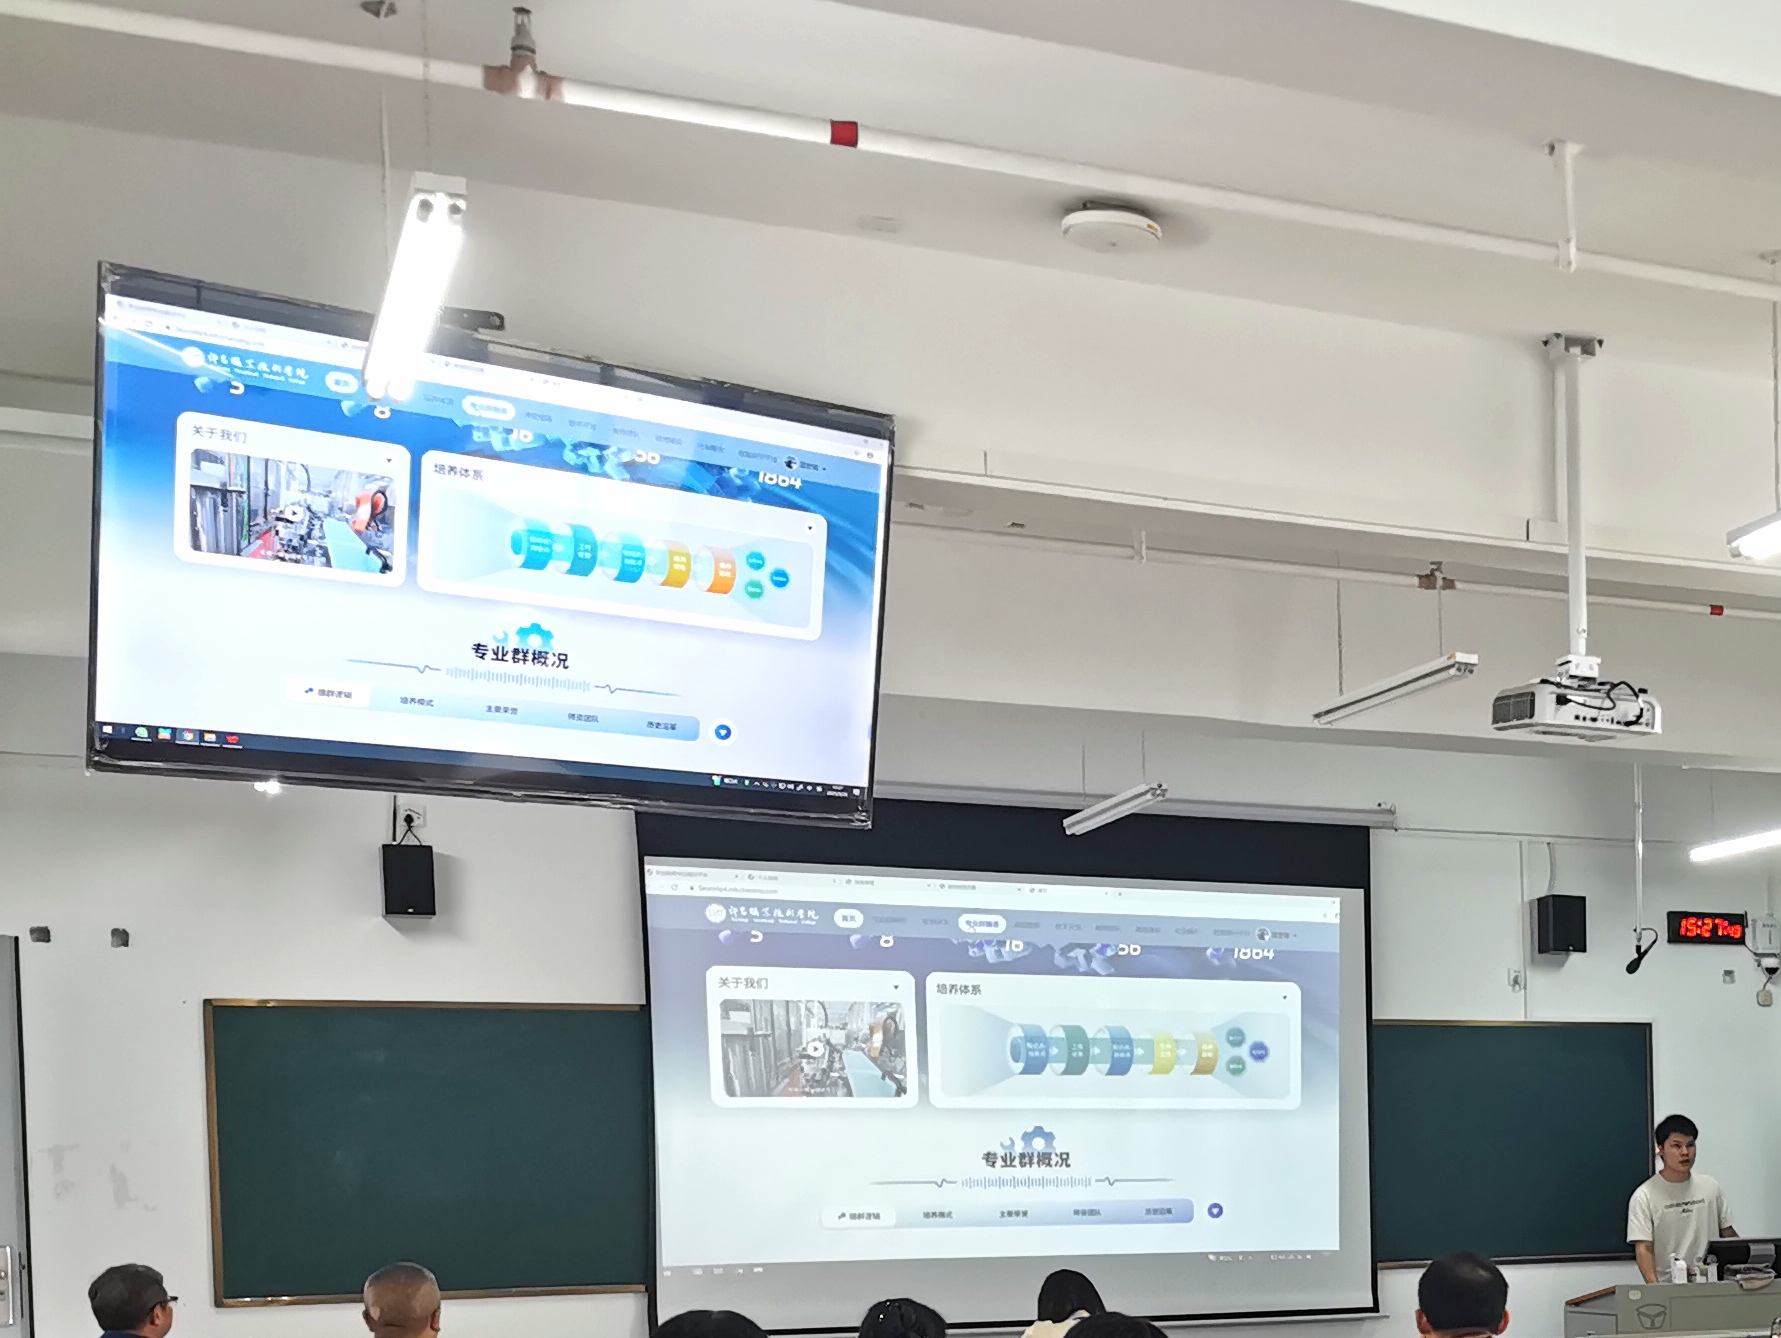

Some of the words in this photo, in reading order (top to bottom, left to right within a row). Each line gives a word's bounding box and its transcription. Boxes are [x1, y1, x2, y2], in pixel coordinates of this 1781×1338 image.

[190, 423, 248, 445] 关于我们
[433, 462, 484, 481] 培养体系
[470, 642, 570, 670] 专业群概况
[717, 976, 769, 990] 关于我们
[936, 982, 982, 996] 培养体系
[981, 1151, 1072, 1169] 专业群概况
